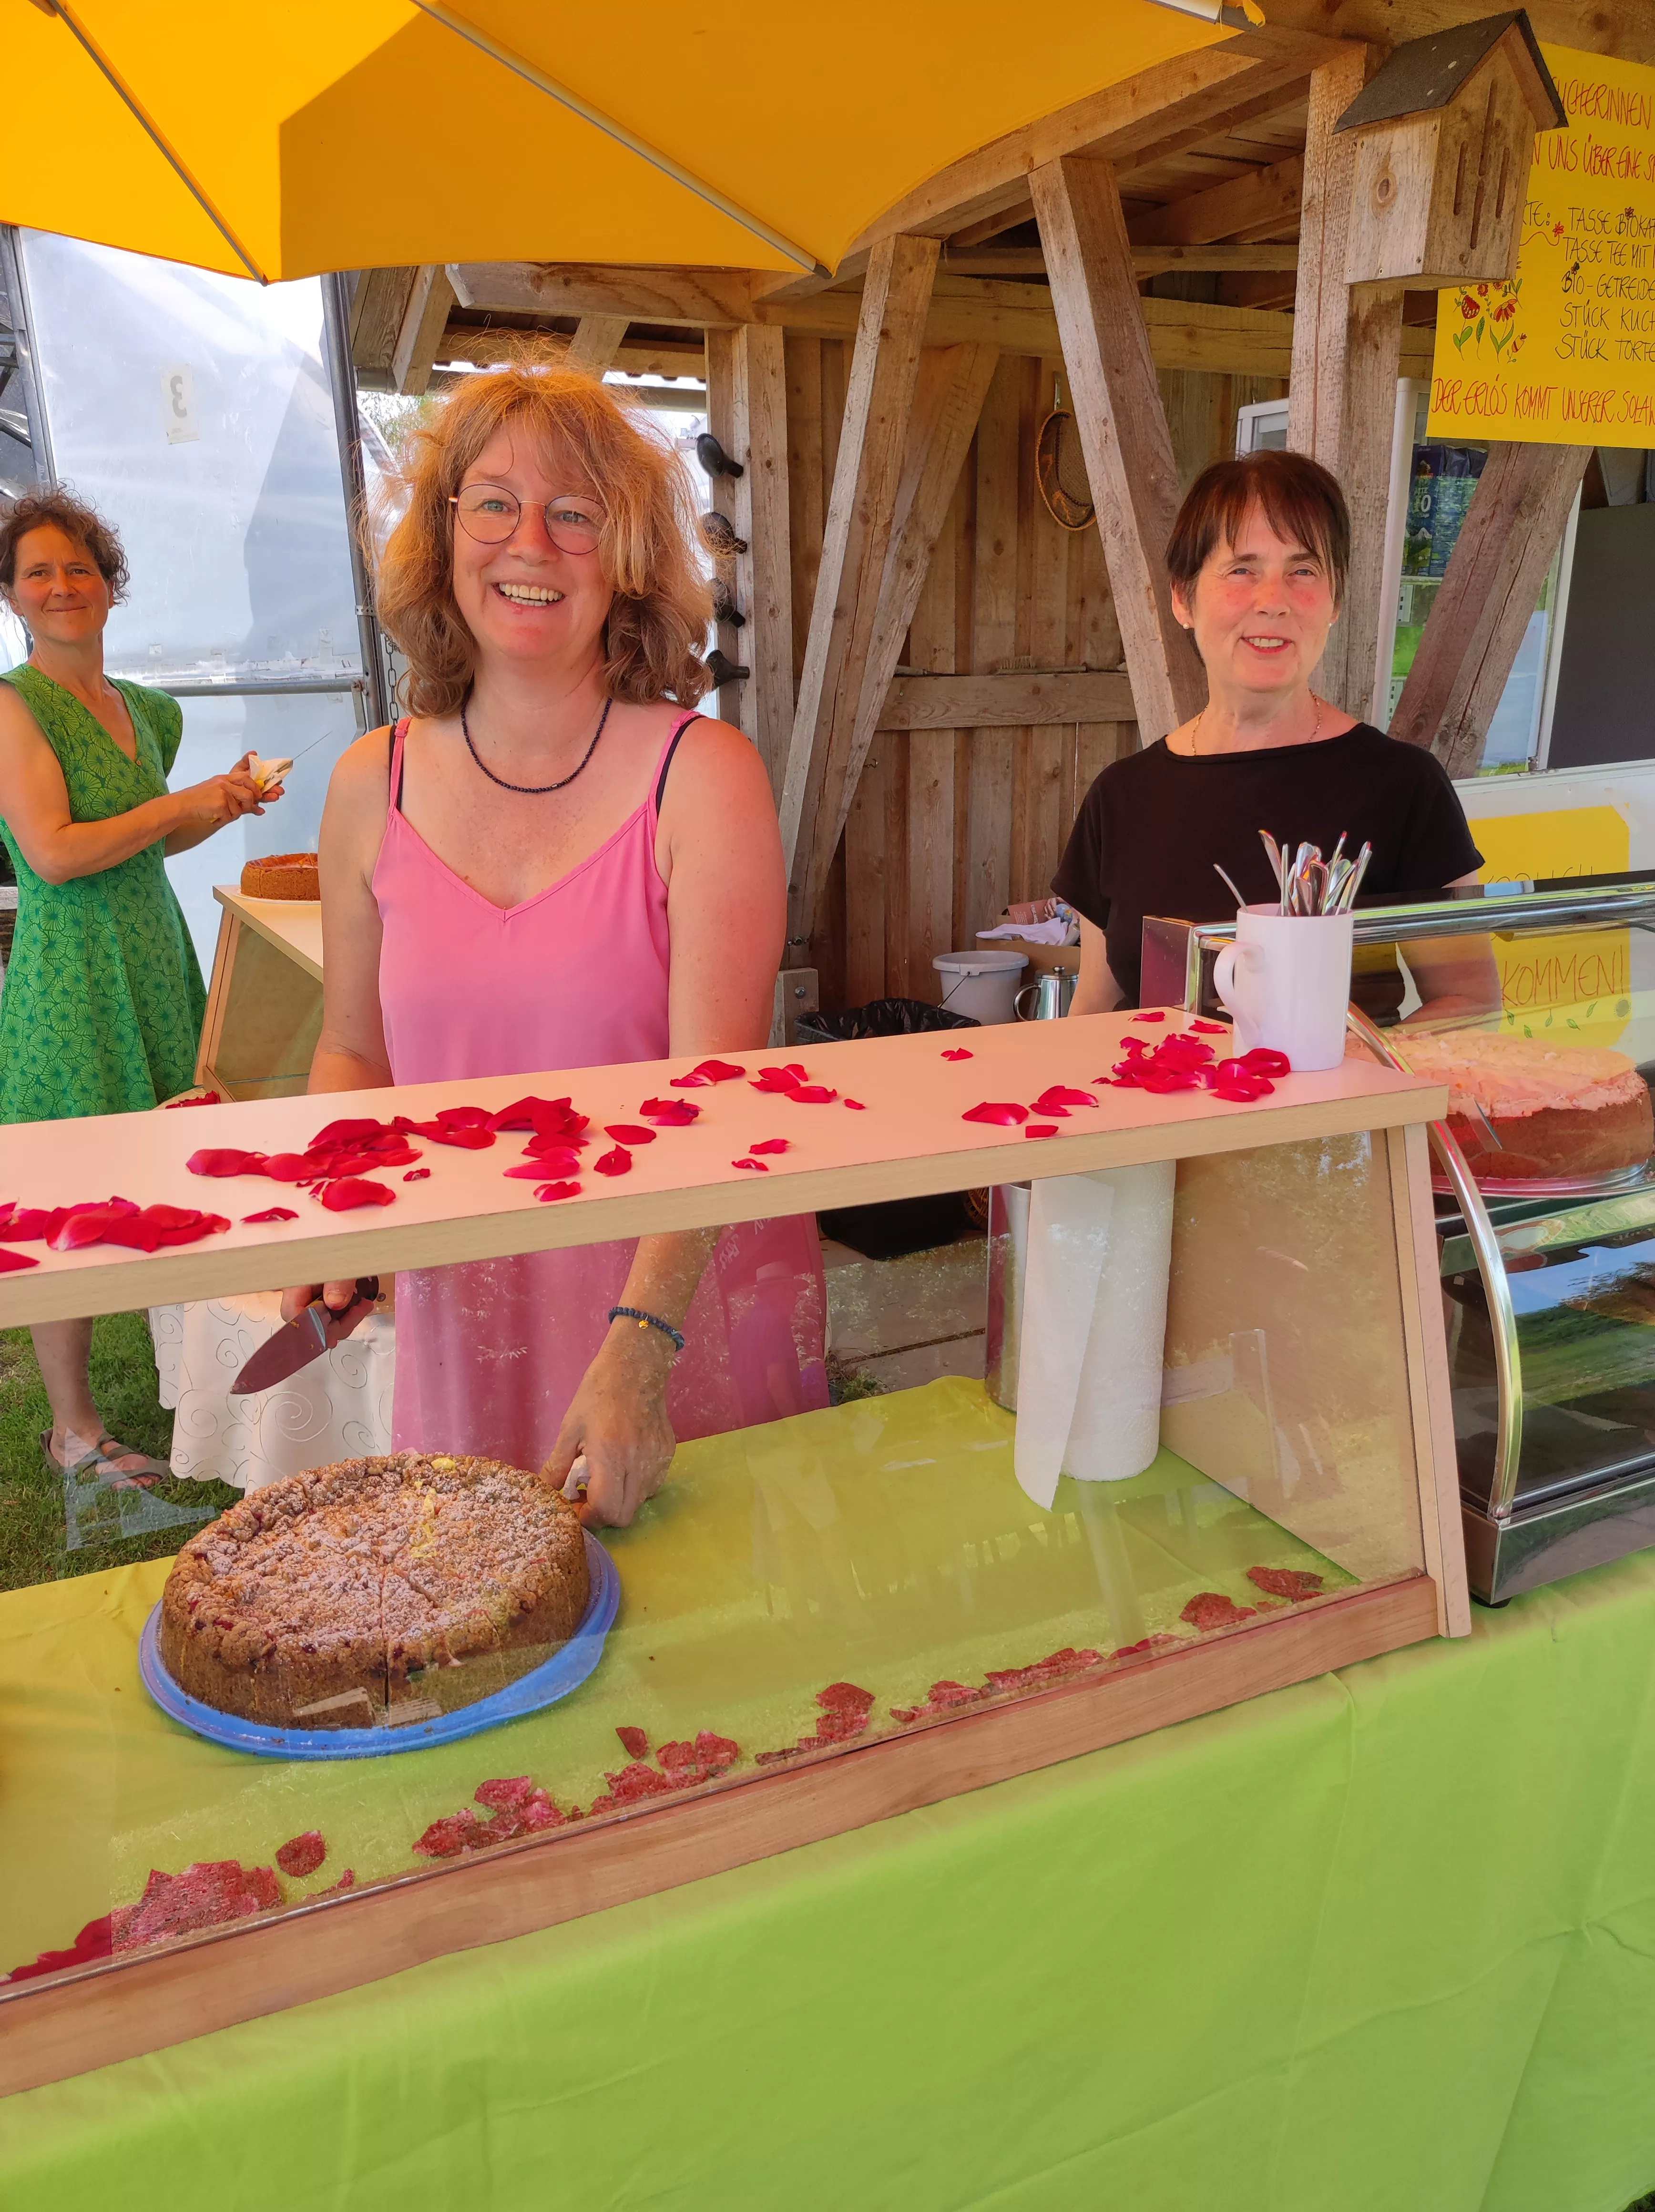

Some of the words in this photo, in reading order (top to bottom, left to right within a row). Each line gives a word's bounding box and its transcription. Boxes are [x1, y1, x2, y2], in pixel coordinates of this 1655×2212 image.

[1549, 134, 1578, 172] UNS
[1583, 133, 1615, 179] ÜBER
[1615, 146, 1643, 179] EINE
[1568, 207, 1612, 235] TASSE
[1563, 237, 1603, 263] TASSE
[1606, 240, 1628, 266] TEE
[1631, 244, 1652, 268] MIT
[1560, 299, 1610, 330] STÜCK
[1555, 329, 1609, 361] STÜCK
[1614, 338, 1655, 362] TORTE
[1431, 378, 1462, 415] DER
[1463, 374, 1508, 417] ERLÖS
[1514, 383, 1559, 420] KOMMT
[1563, 387, 1616, 423] UNSERER
